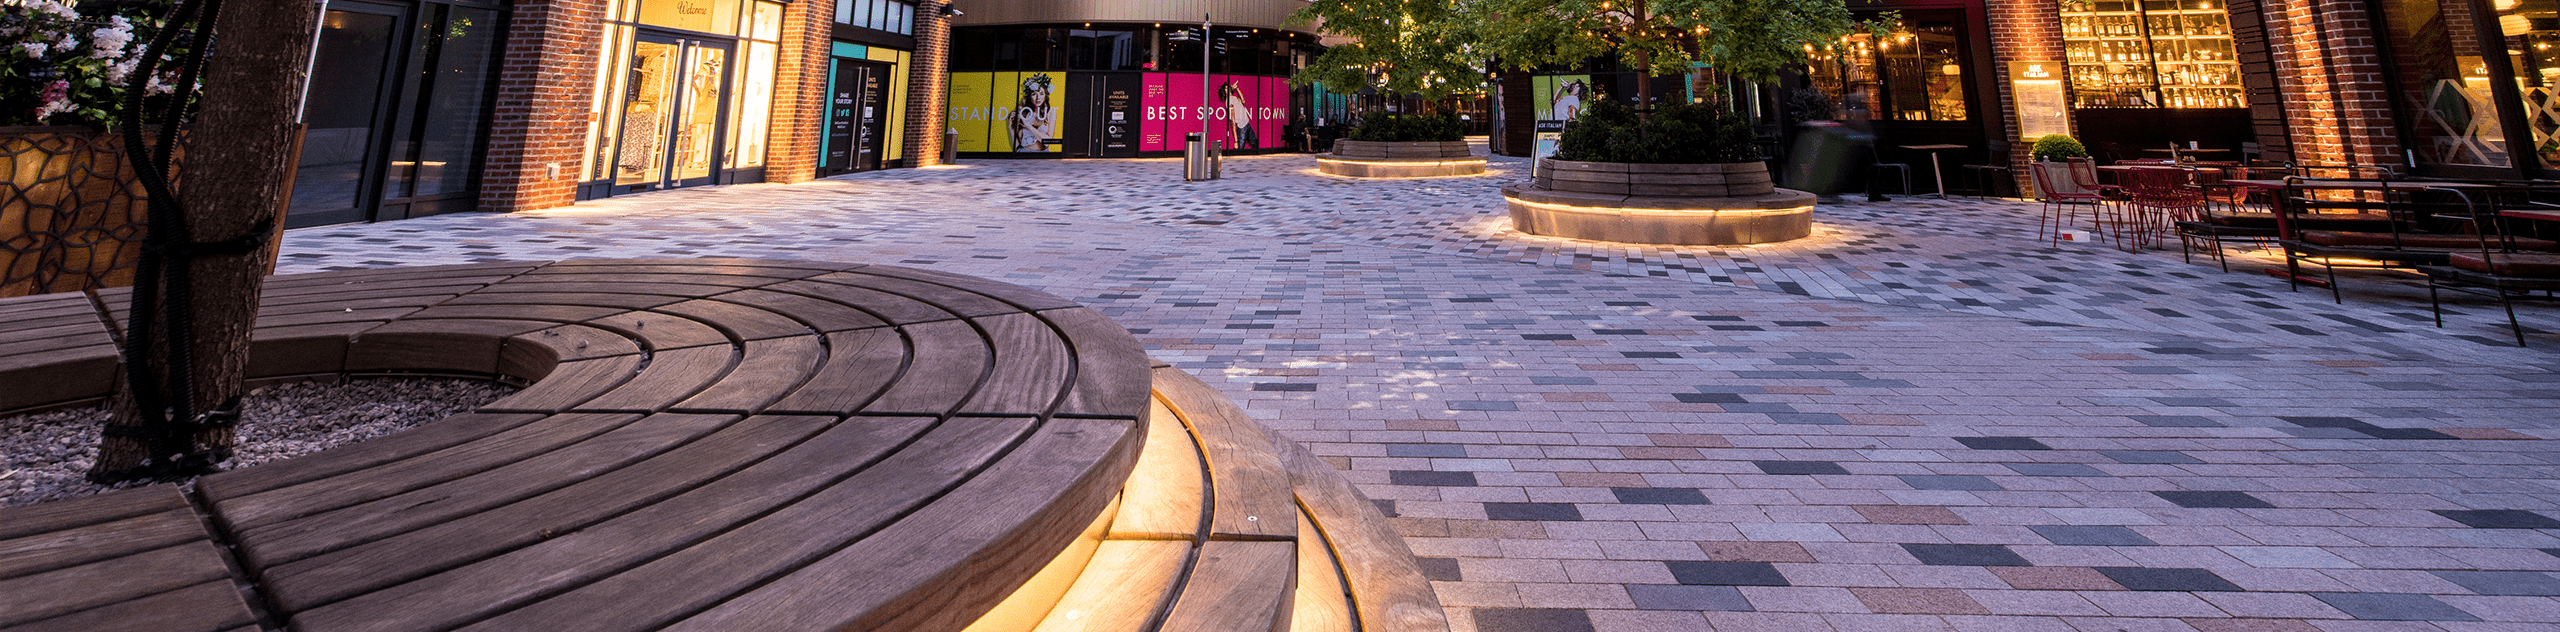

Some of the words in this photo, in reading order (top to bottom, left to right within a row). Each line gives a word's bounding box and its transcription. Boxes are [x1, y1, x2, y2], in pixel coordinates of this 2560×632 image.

[677, 0, 708, 15] Welcome
[950, 106, 1009, 121] STAND
[1019, 106, 1059, 121] OUT
[1147, 106, 1187, 120] BEST
[1197, 106, 1234, 120] SPOT
[1259, 107, 1285, 120] TOWN
